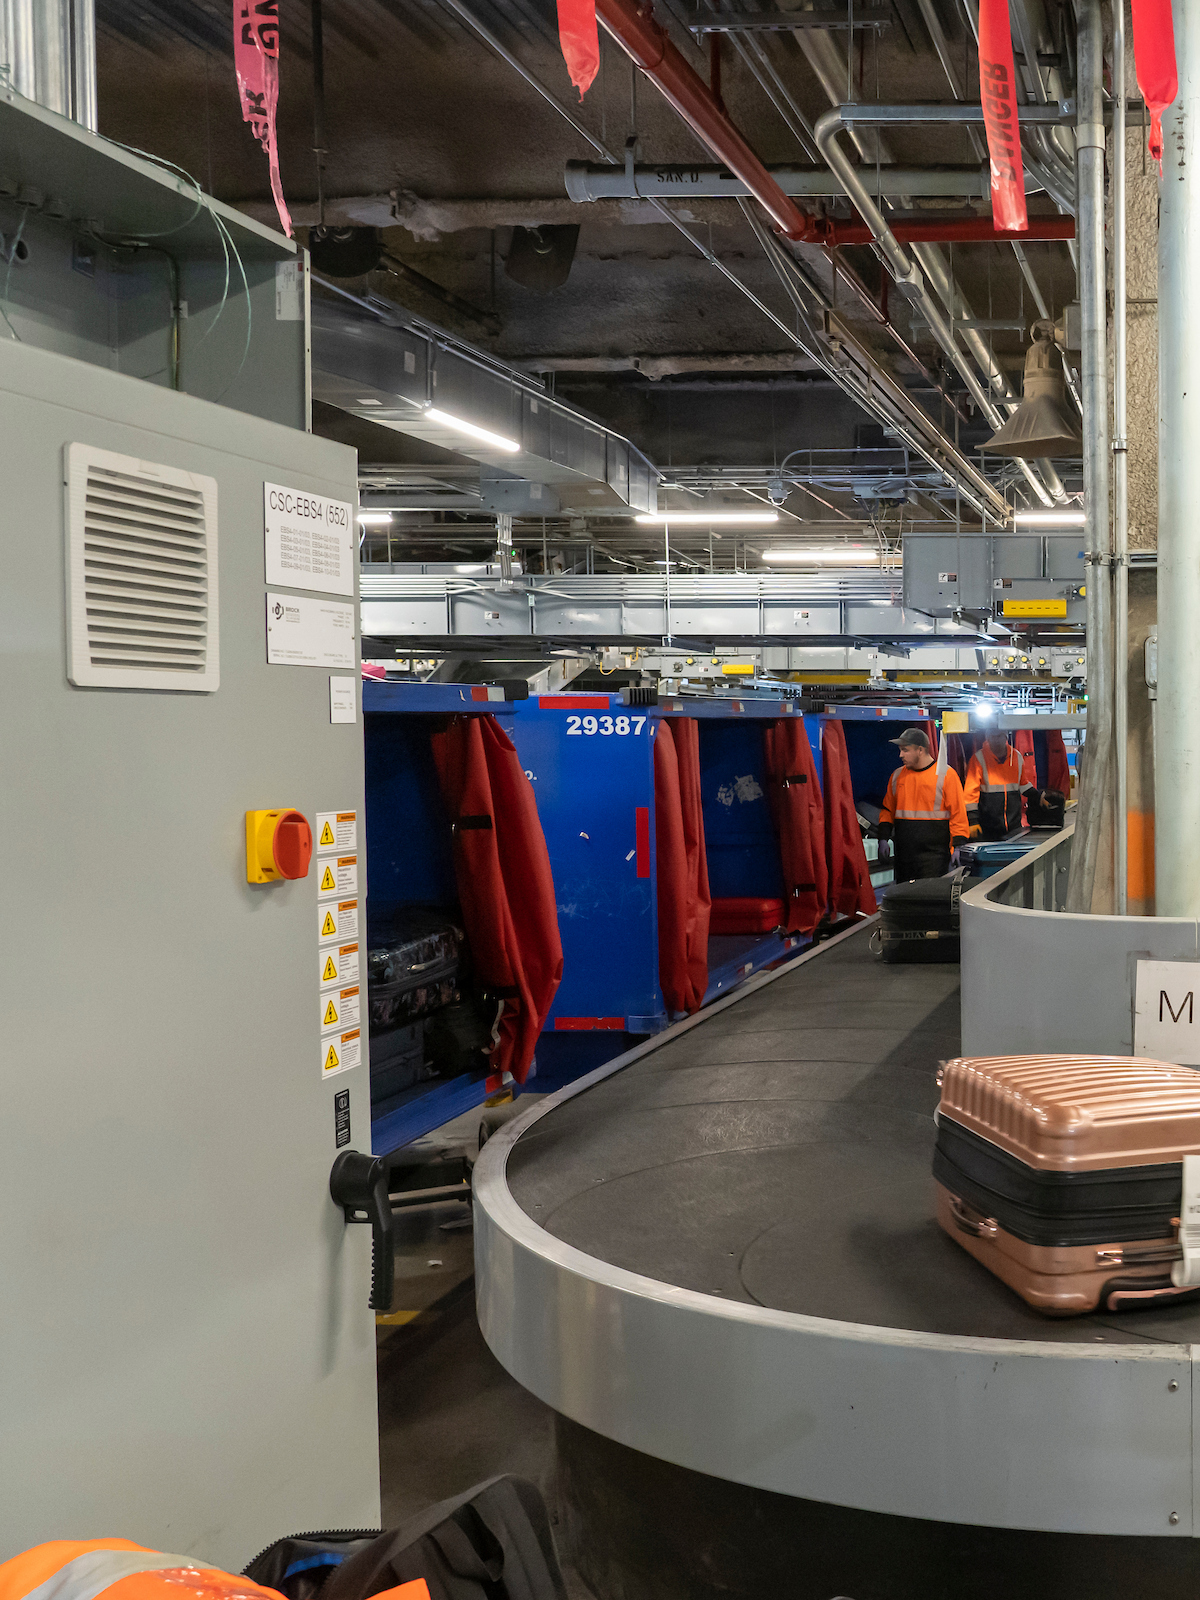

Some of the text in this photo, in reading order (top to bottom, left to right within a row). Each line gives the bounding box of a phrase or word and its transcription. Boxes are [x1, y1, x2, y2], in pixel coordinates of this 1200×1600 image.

[269, 490, 349, 531] CSC-EBS4 (552)
[566, 715, 647, 736] 29387
